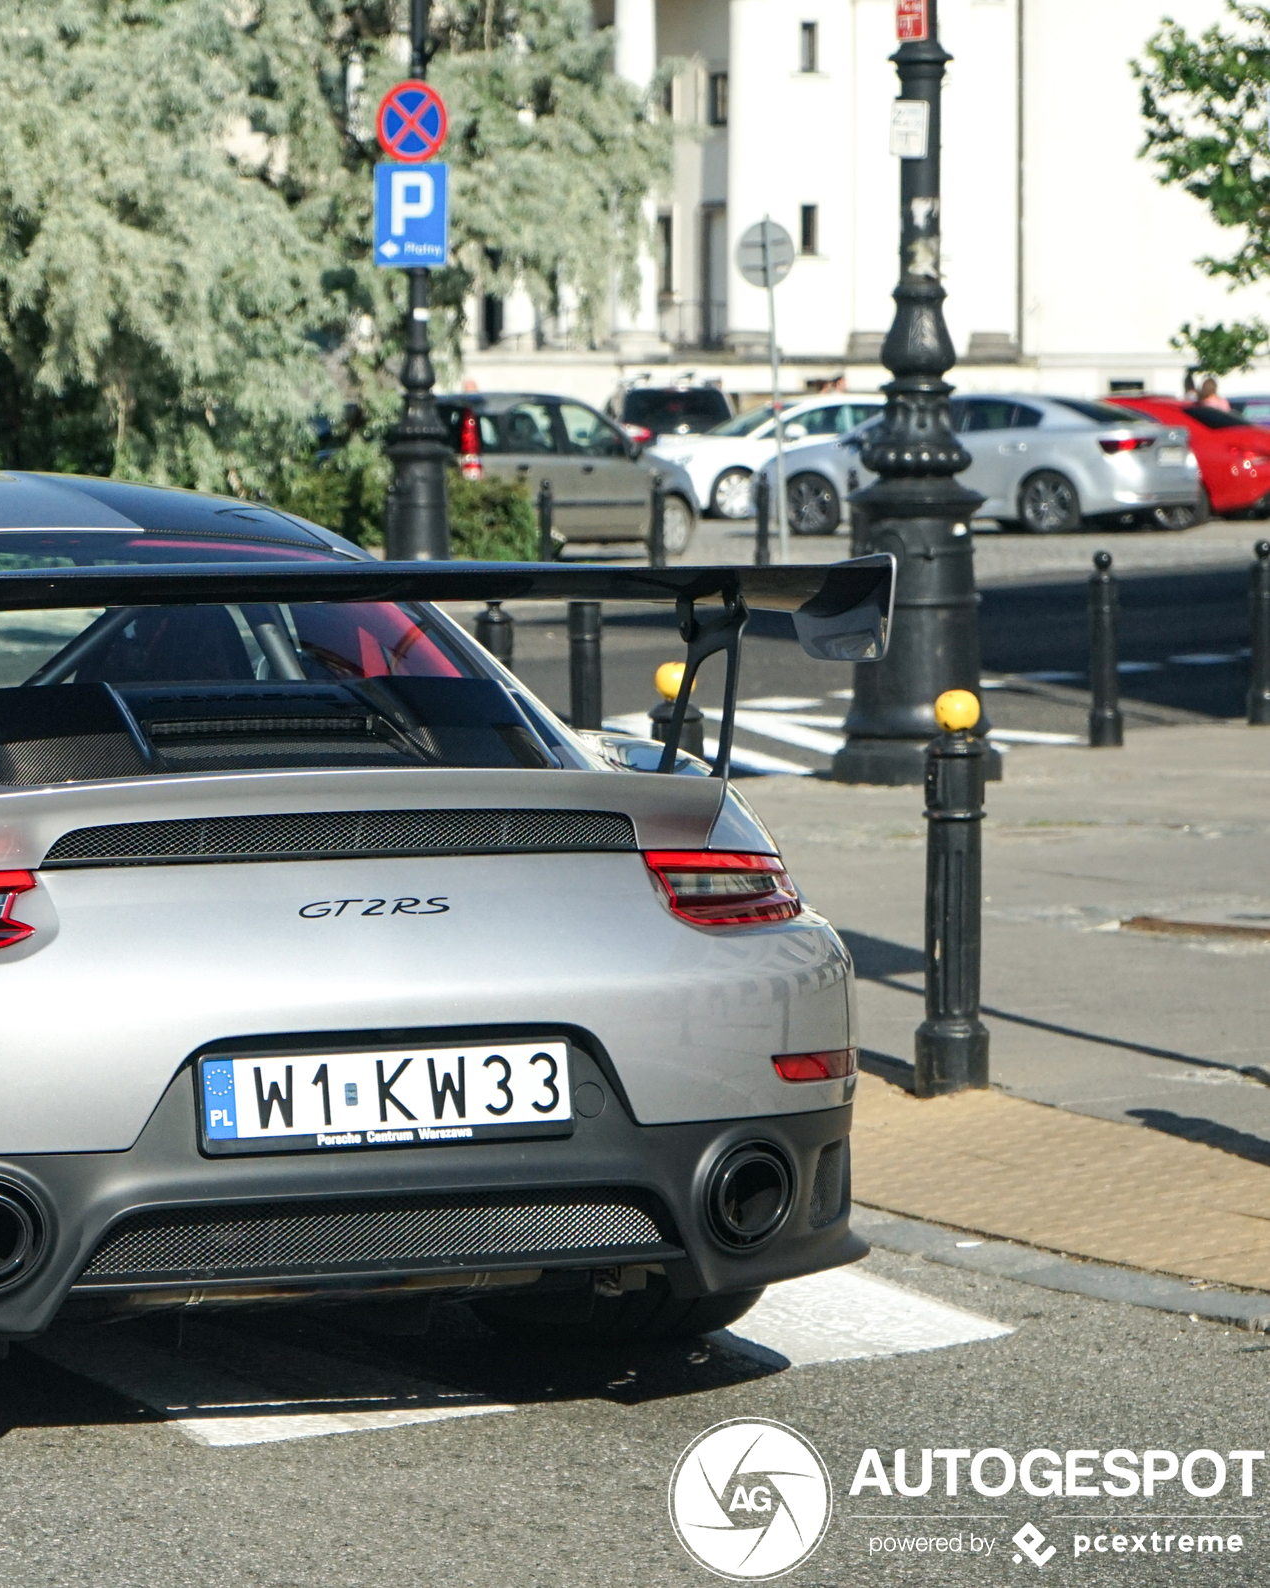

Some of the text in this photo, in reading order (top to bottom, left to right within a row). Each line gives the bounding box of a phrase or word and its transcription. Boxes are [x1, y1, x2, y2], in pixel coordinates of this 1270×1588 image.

[391, 171, 434, 236] P
[253, 1051, 560, 1130] W1 KW33
[210, 1109, 233, 1128] PL
[316, 1126, 473, 1147] Porsche Centrum Warszawa
